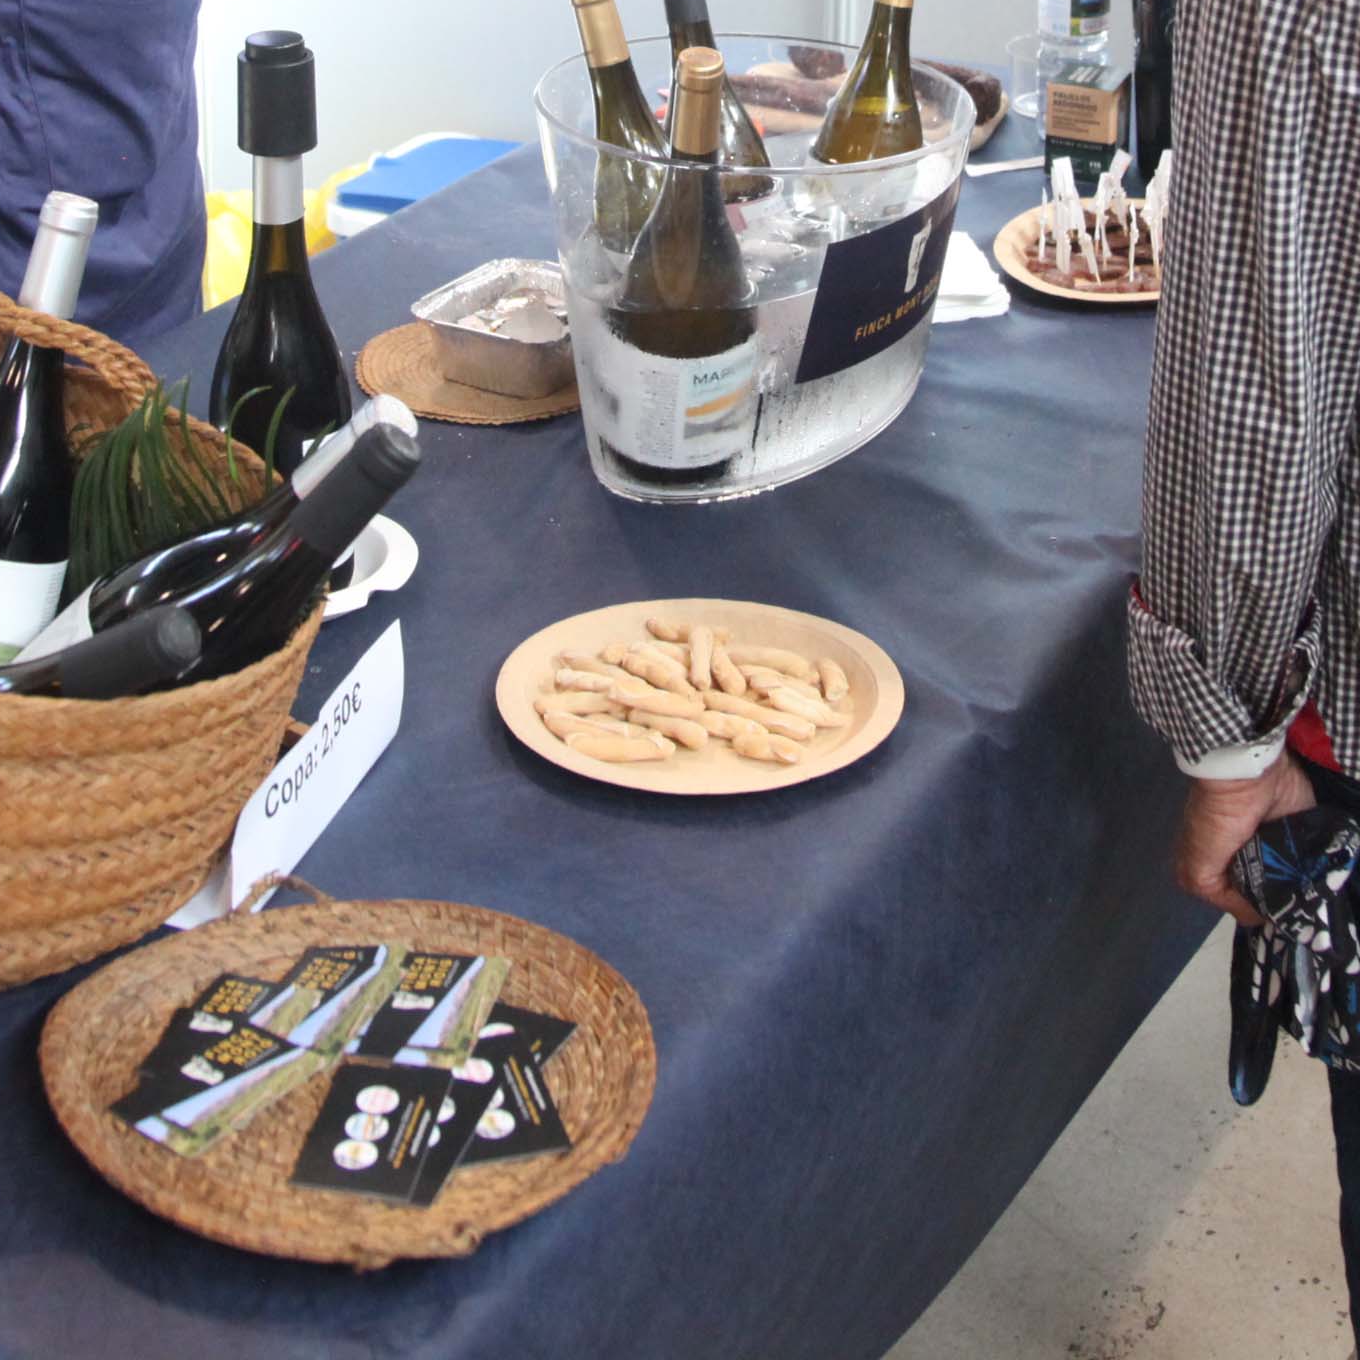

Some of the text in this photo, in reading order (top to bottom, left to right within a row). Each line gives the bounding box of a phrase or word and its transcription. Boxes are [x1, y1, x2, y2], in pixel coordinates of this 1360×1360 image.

[854, 313, 892, 342] FINCA
[264, 682, 362, 819] Copa: 2,50€
